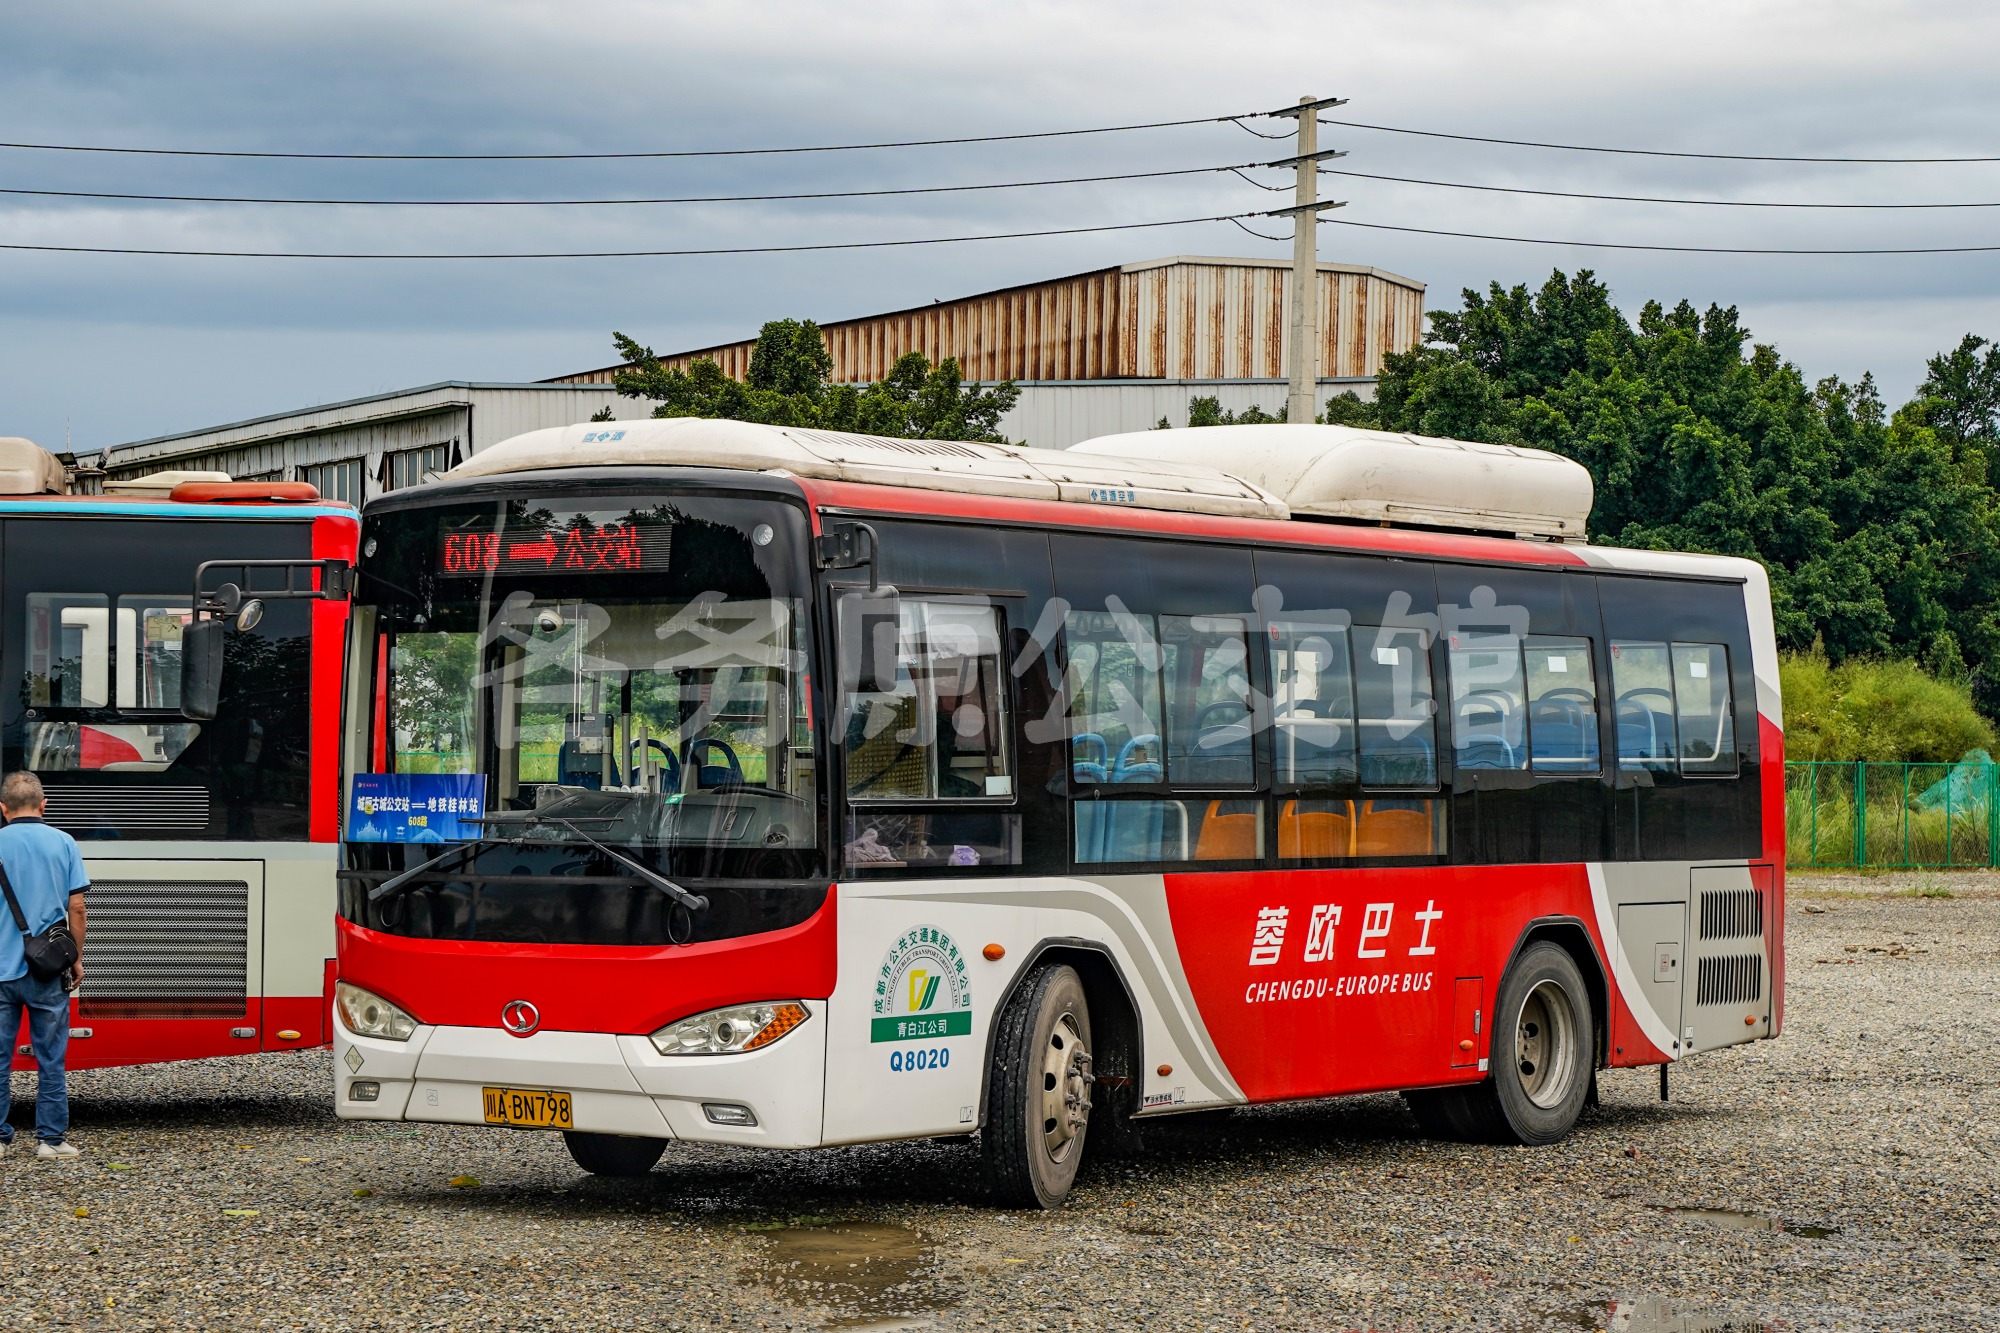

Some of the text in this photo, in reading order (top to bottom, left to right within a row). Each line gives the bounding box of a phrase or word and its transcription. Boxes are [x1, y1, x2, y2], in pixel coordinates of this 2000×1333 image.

[444, 525, 645, 572] 608 公交站
[427, 796, 479, 814] 地铁桂林站
[1248, 899, 1444, 967] 蓉欧巴士
[873, 927, 971, 1014] 成都市公共交通集团有限公司
[1245, 971, 1433, 1004] CHENGDU-EUROPE BUS
[897, 1019, 948, 1038] 青白江公司
[889, 1047, 950, 1073] Q8020
